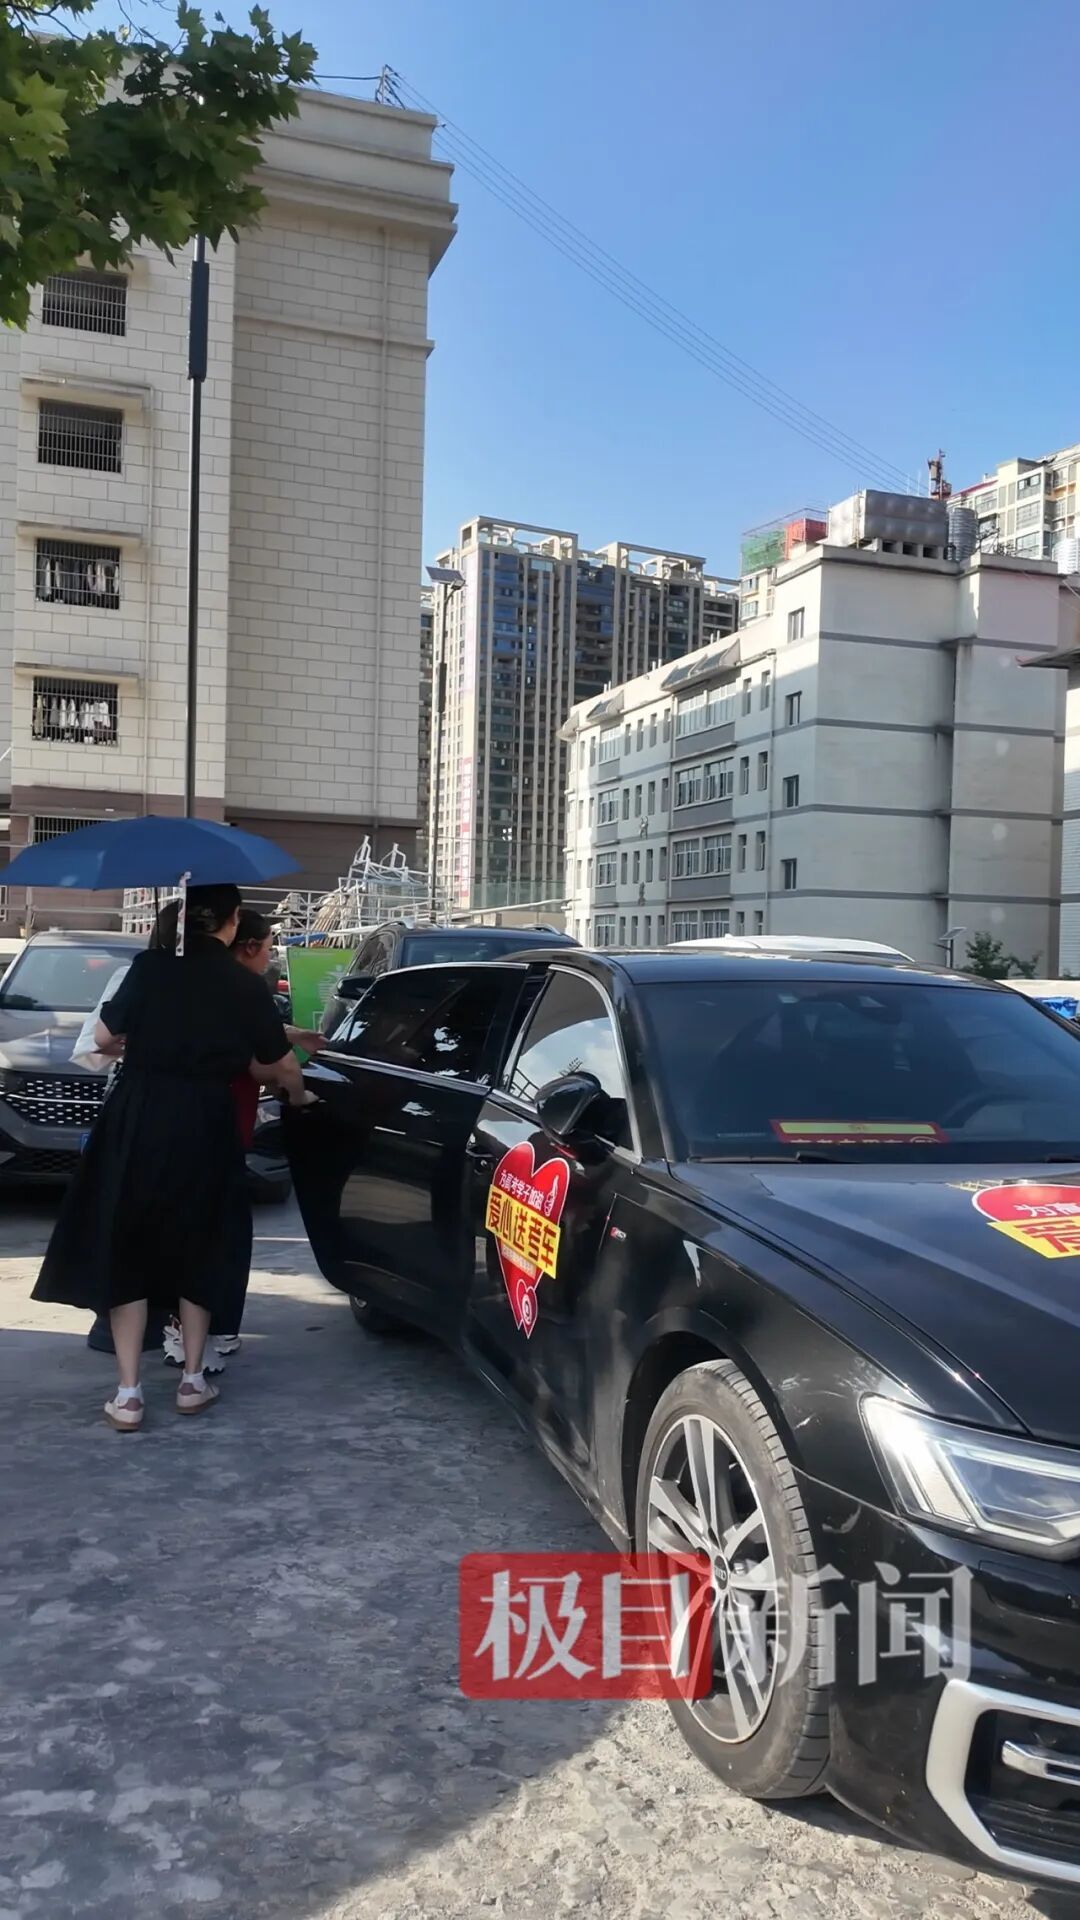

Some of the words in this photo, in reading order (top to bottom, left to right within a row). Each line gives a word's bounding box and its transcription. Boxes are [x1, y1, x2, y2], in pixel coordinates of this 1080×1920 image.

[489, 1191, 557, 1269] 爱心送考车
